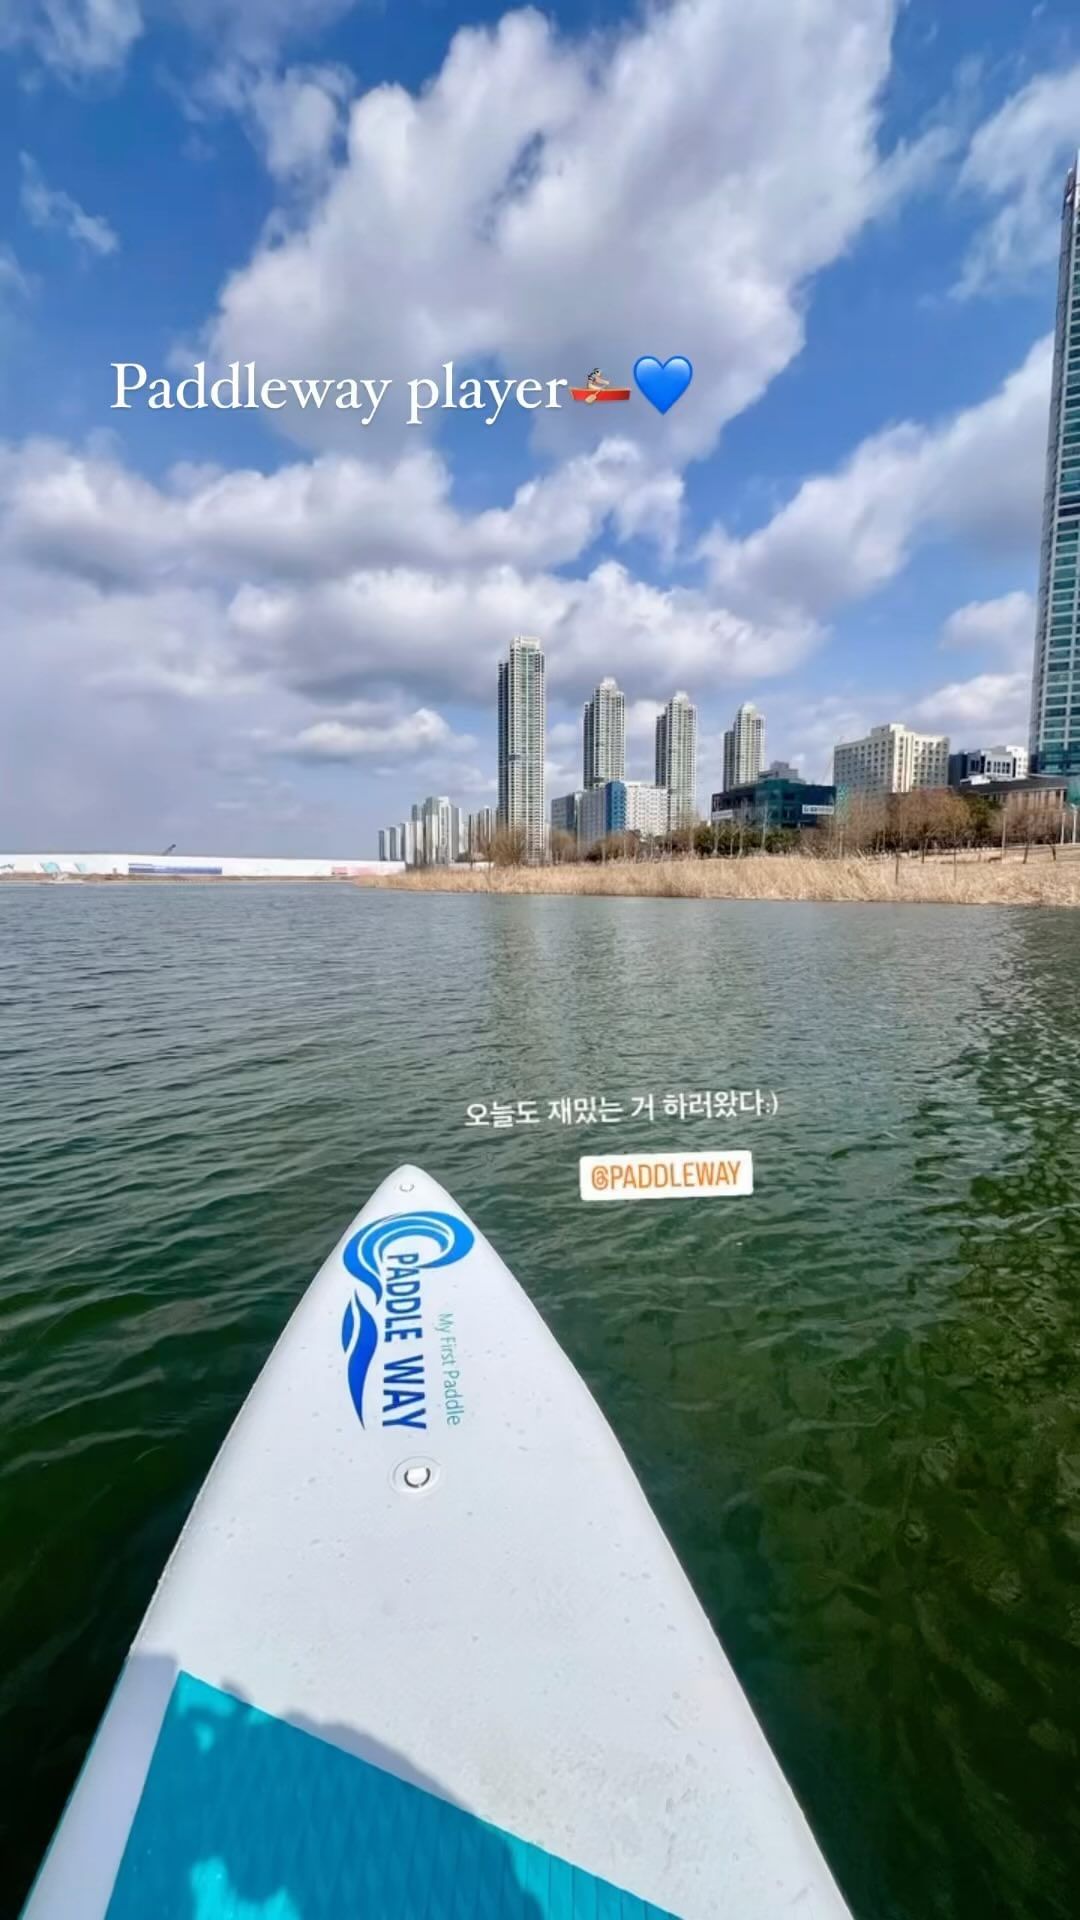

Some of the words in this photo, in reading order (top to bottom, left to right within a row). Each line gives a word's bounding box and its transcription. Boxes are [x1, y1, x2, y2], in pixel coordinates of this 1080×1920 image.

[384, 1252, 423, 1343] PADDLE
[435, 1313, 454, 1333] My
[440, 1336, 457, 1366] First
[382, 1354, 427, 1430] WAY
[442, 1369, 465, 1427] Paddle
